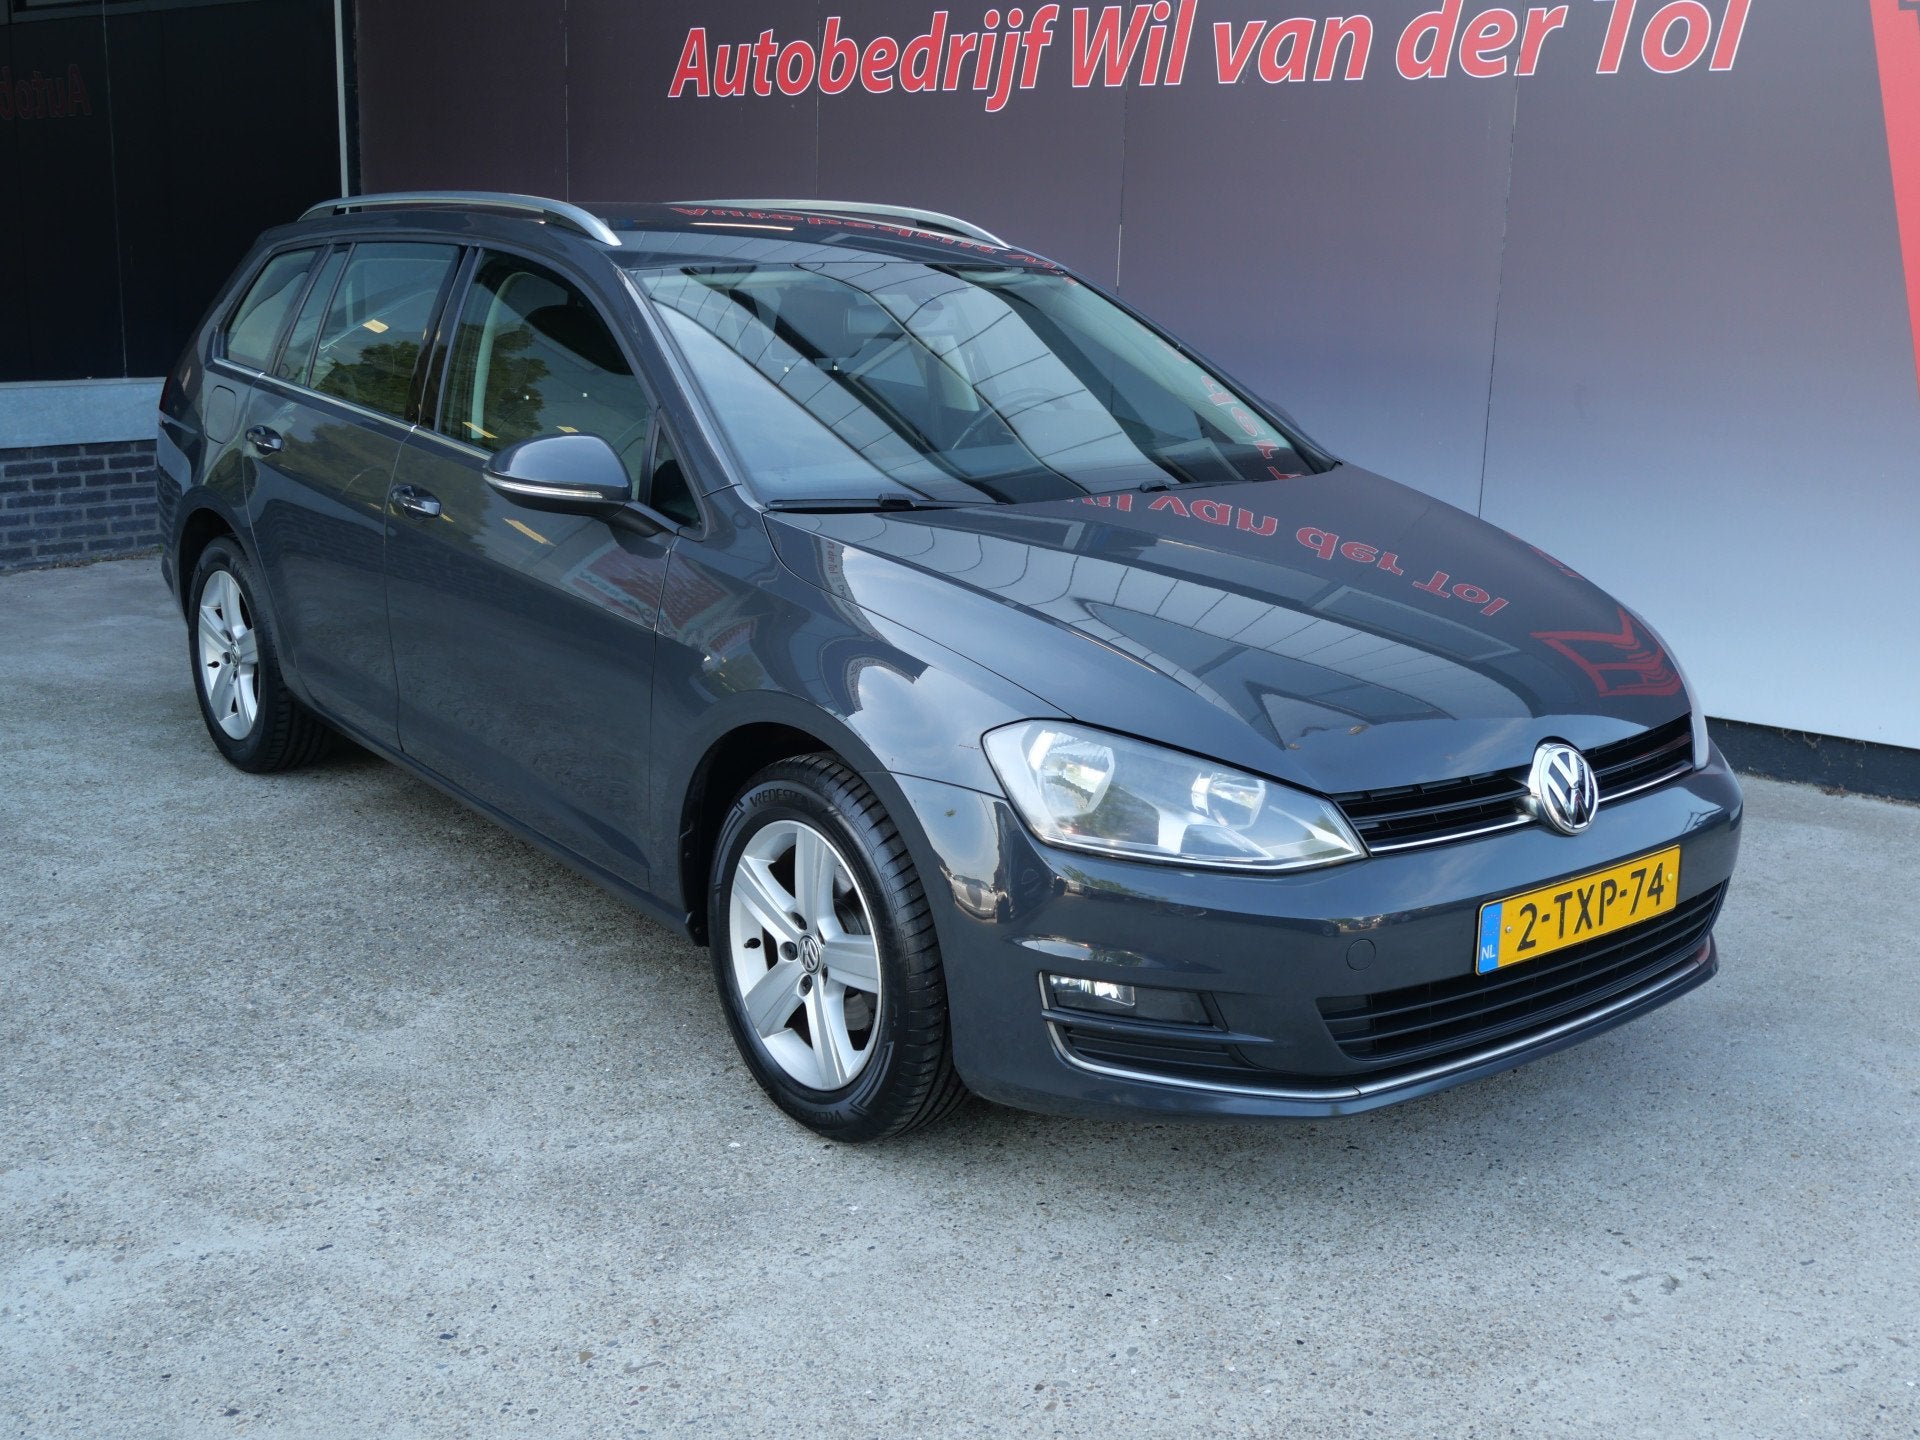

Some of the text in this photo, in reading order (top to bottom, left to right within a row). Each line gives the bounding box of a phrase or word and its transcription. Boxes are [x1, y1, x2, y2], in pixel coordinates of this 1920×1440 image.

[667, 0, 1752, 112] Autobedrijf Wil van der Tol
[1516, 862, 1665, 952] 2-TXP-74
[1481, 944, 1496, 961] NL
